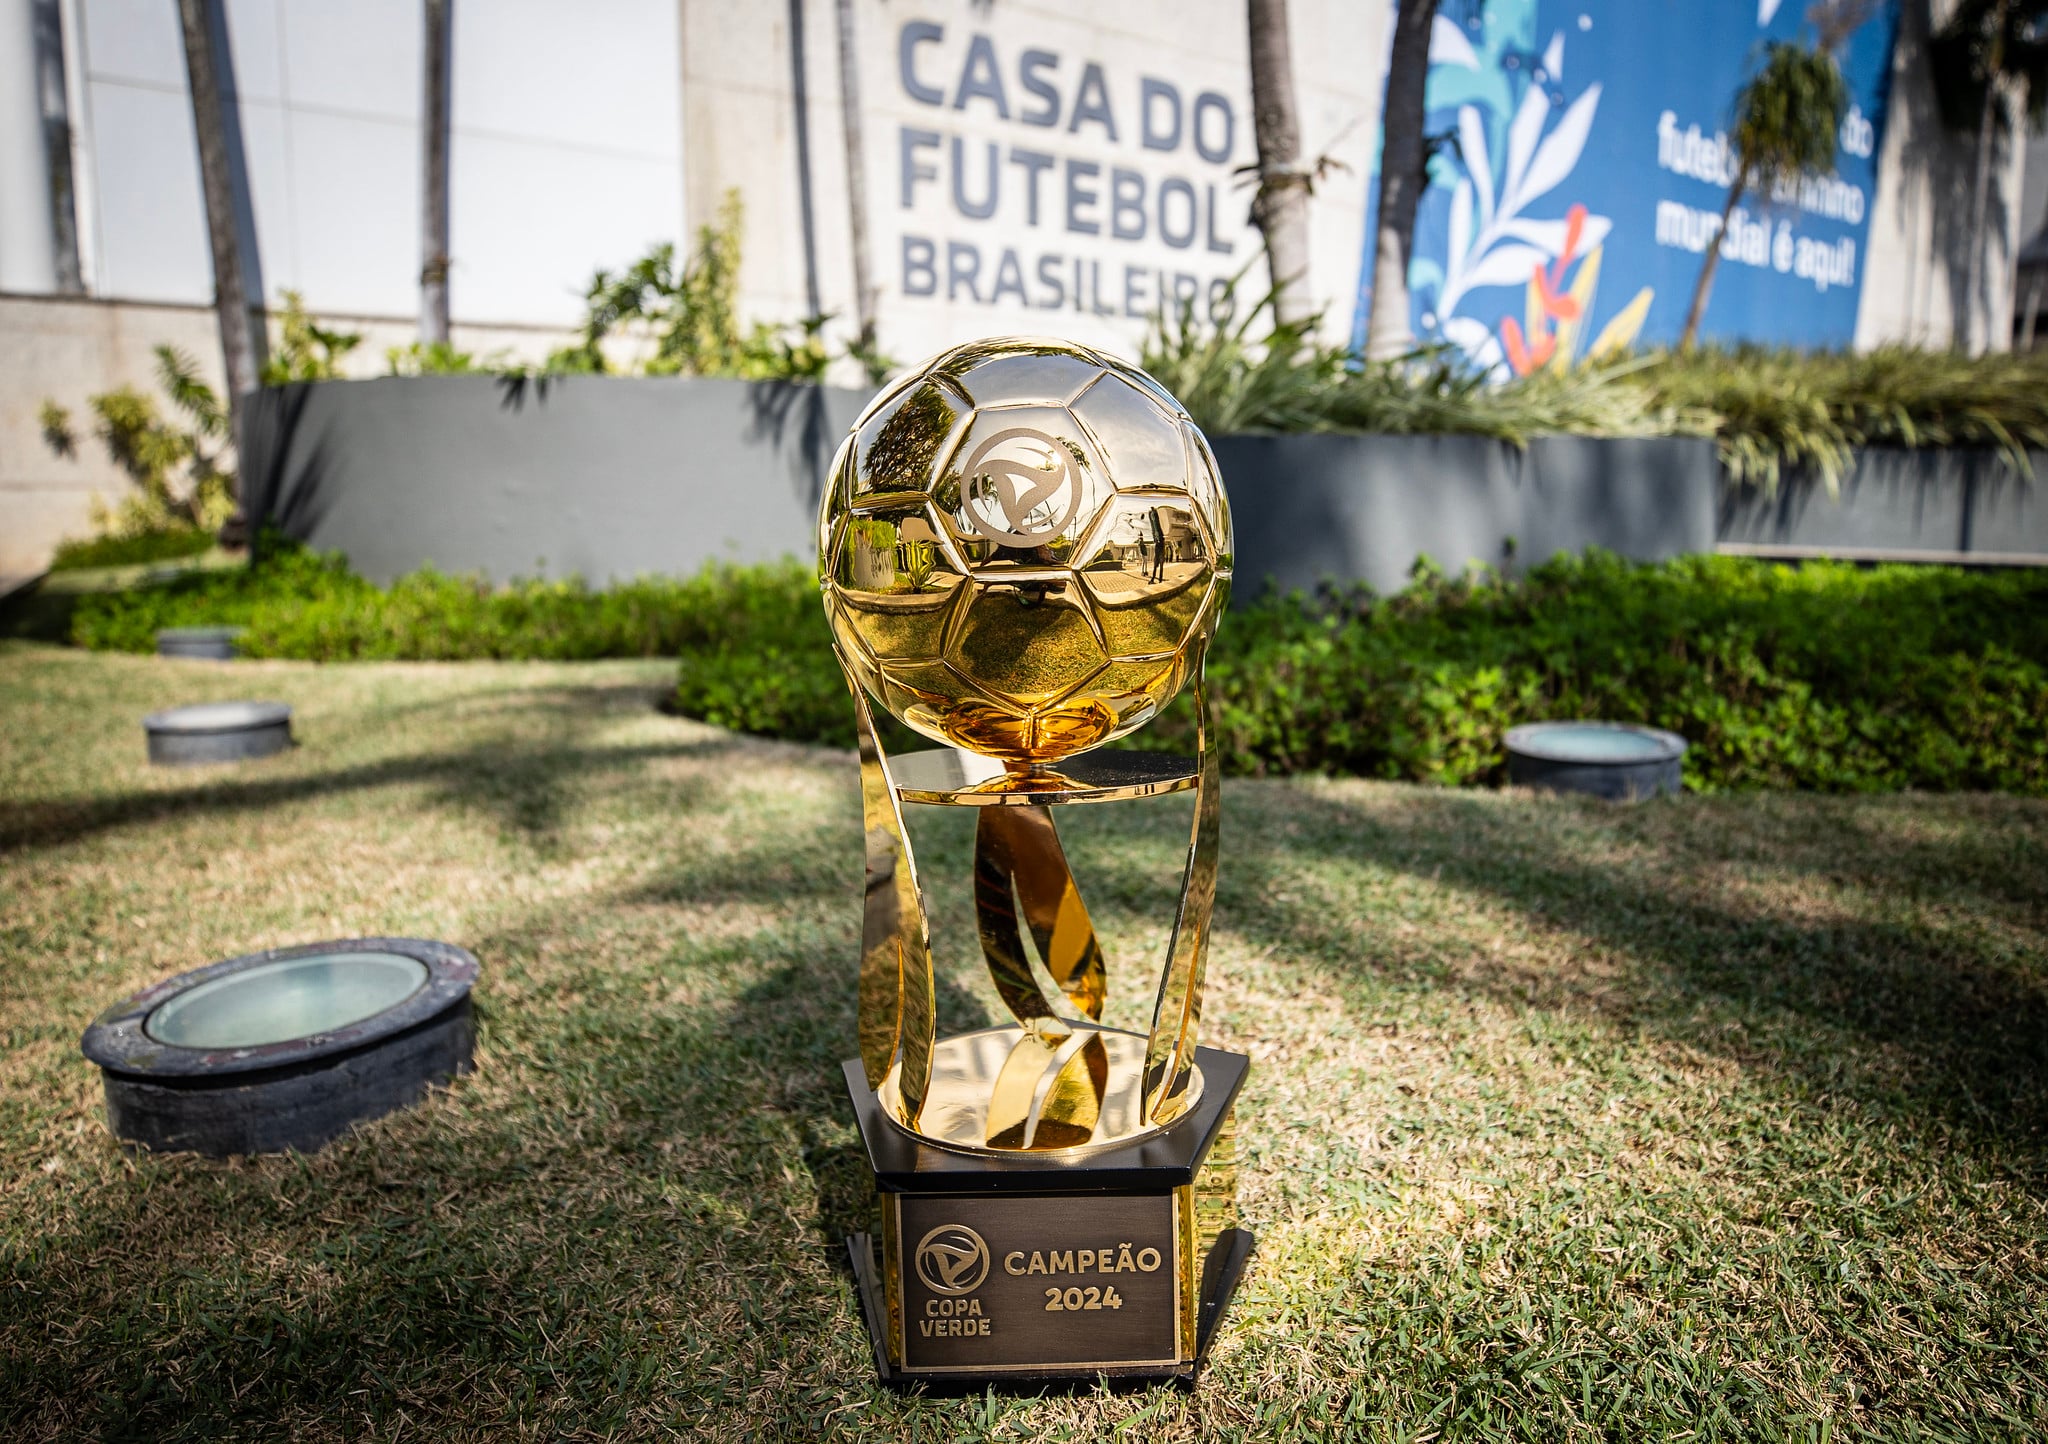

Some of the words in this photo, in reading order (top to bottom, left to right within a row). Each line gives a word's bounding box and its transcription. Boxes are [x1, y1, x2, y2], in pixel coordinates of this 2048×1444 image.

[899, 21, 1119, 142] CASA
[1140, 76, 1236, 164] DO
[899, 126, 1235, 255] FUTEBOL
[1772, 219, 1794, 274] é
[1003, 1242, 1162, 1276] CAMPEÃO
[925, 1299, 983, 1318] COPA
[1044, 1286, 1123, 1312] 2024
[919, 1318, 992, 1338] VERDE
